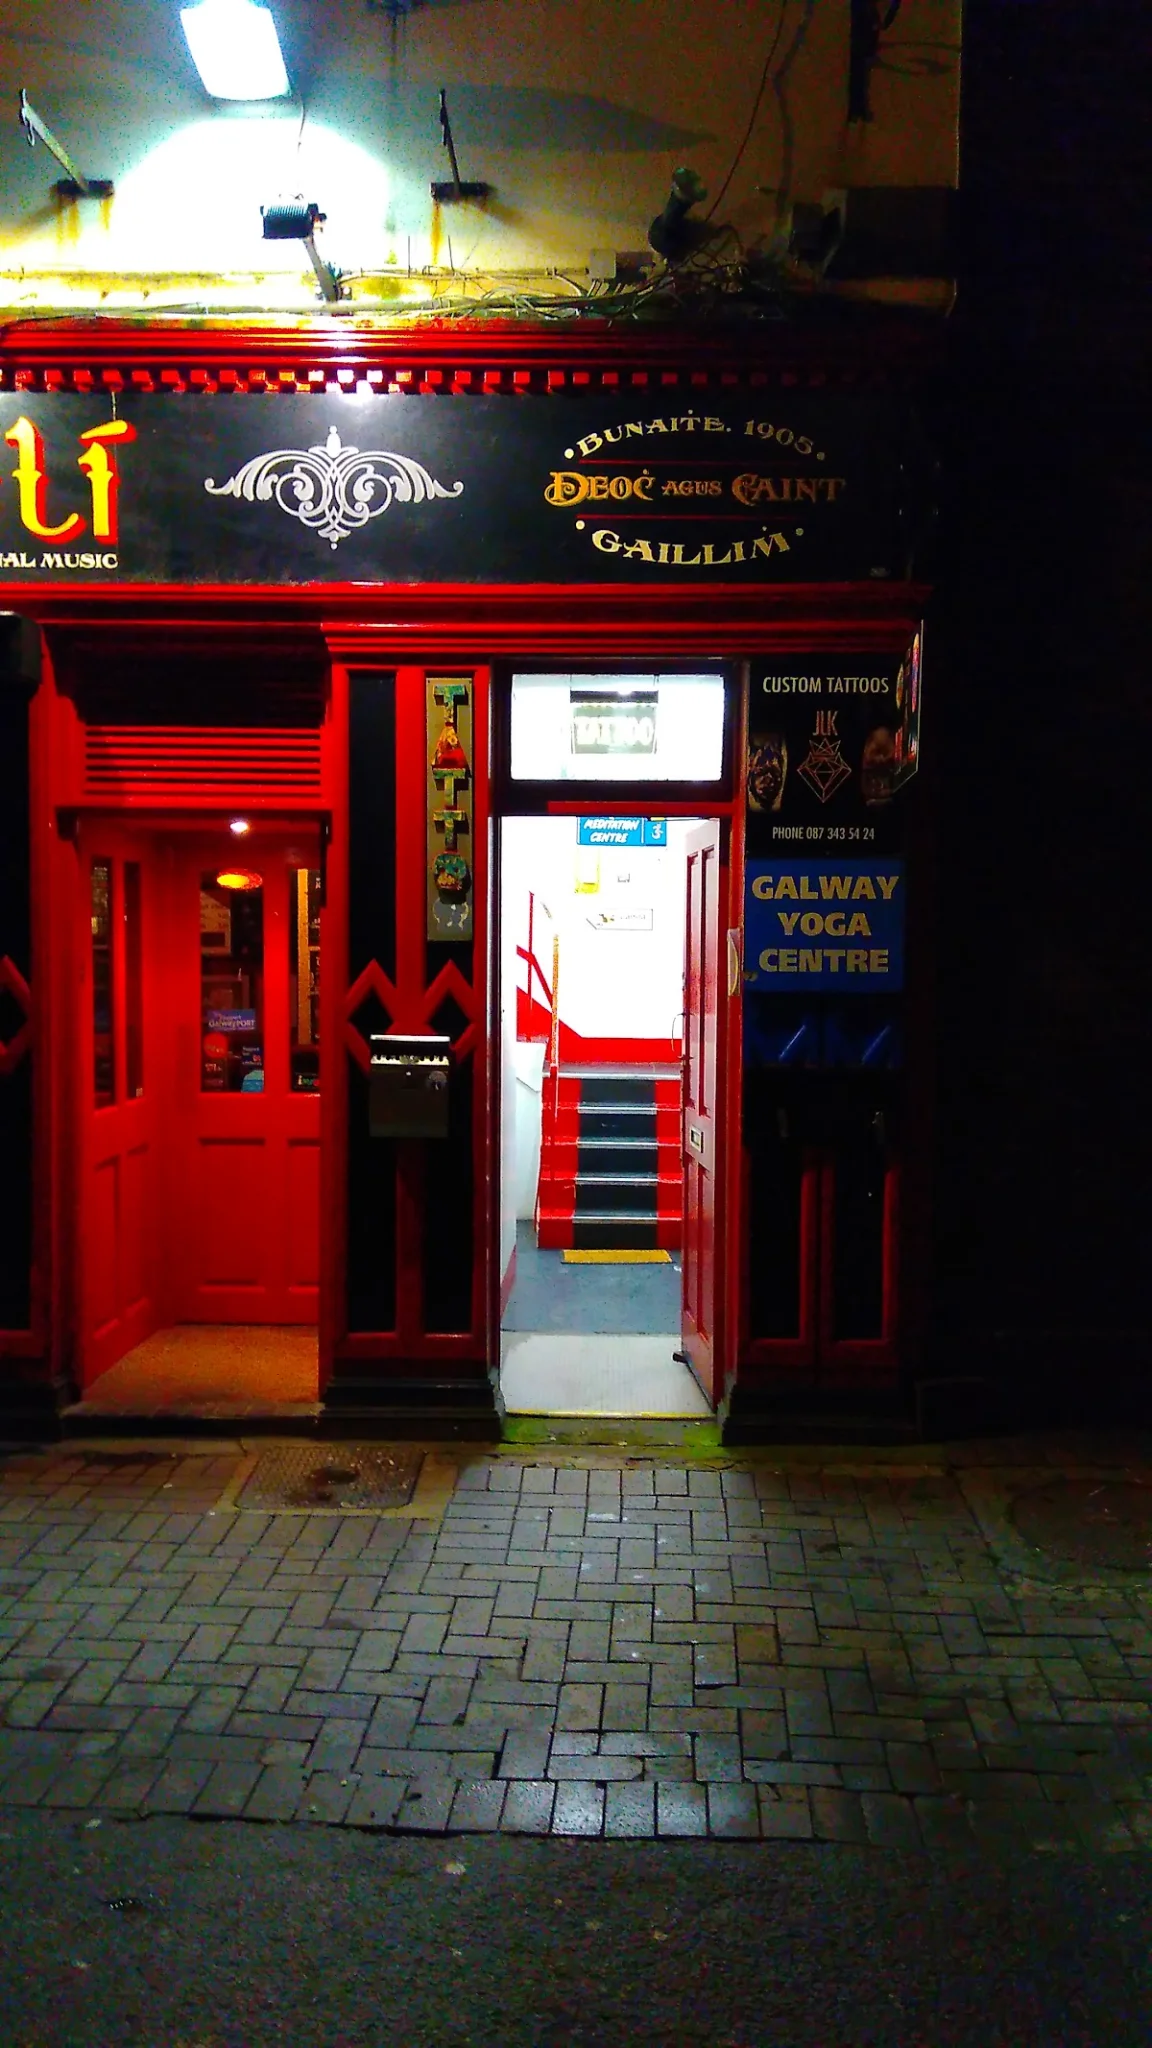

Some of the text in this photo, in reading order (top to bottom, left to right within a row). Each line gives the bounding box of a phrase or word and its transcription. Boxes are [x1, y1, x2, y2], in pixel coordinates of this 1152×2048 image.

[661, 480, 723, 496] AGUS
[731, 473, 847, 507] CAINT
[41, 552, 119, 569] MUSIC
[763, 677, 890, 693] CUSTOM TATTOOS
[583, 818, 641, 831] MEDITATION
[772, 826, 875, 840] PHONE 087 343 54 24
[590, 831, 629, 843] CENTRE
[751, 875, 899, 900] GALWAY
[777, 912, 872, 936] YOGA
[758, 948, 889, 973] CENTRE
